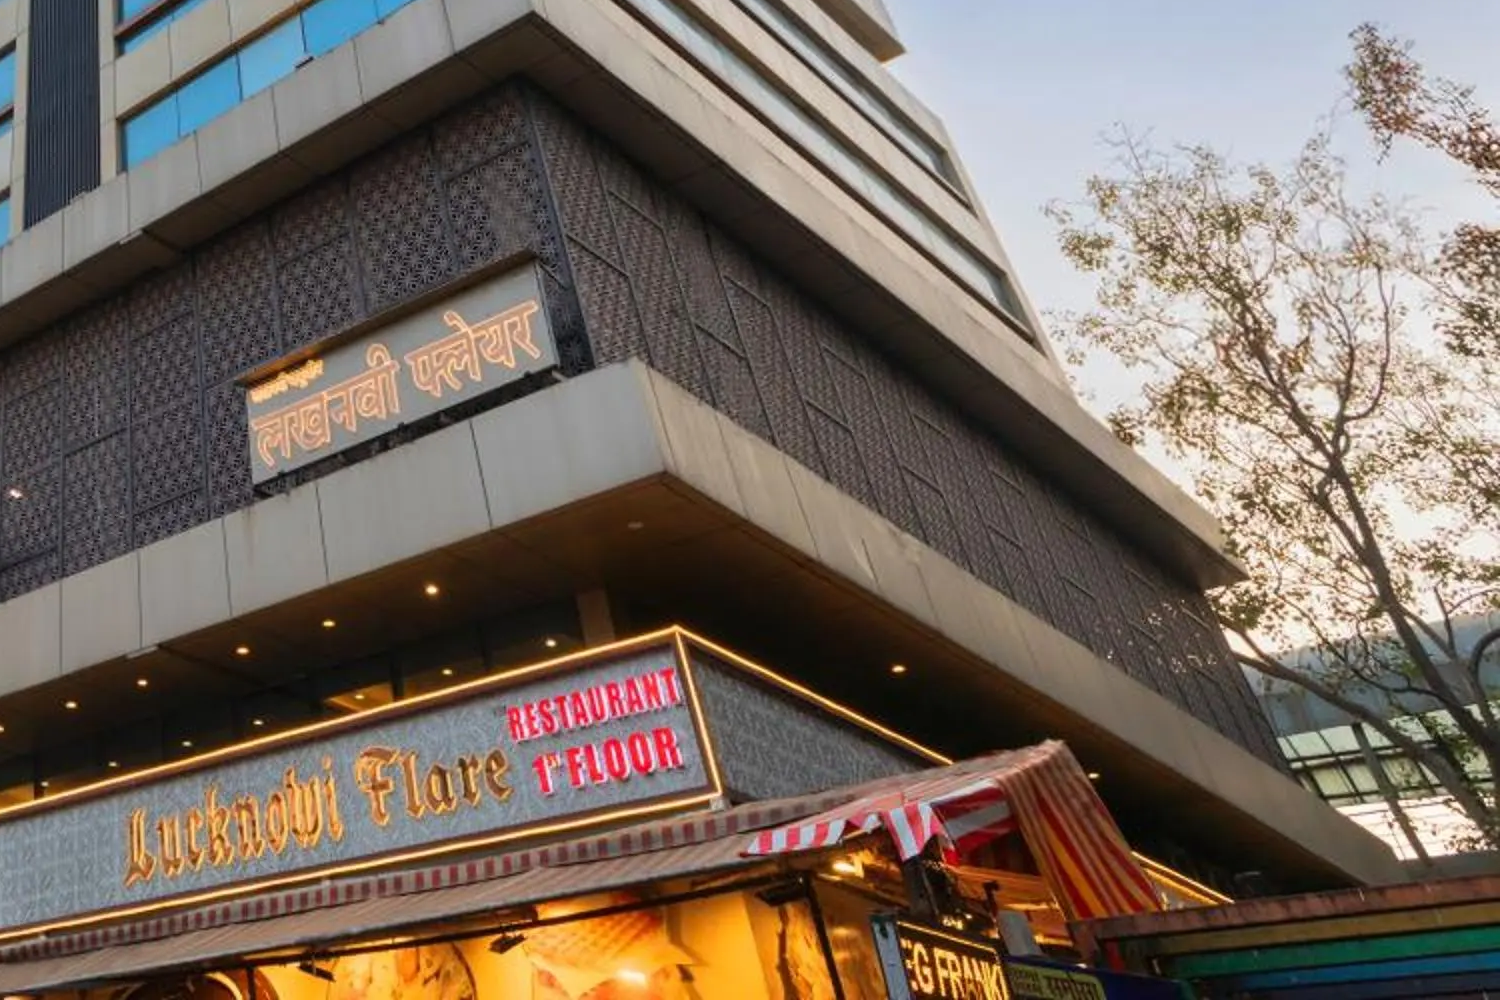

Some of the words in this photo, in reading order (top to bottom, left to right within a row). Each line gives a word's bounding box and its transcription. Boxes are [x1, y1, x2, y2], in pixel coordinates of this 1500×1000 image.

[252, 344, 400, 468] लखनवी
[507, 666, 681, 743] RESTAURANT
[565, 727, 684, 789] FLOOR
[124, 756, 346, 888] Lucknowi
[355, 744, 515, 827] Flare
